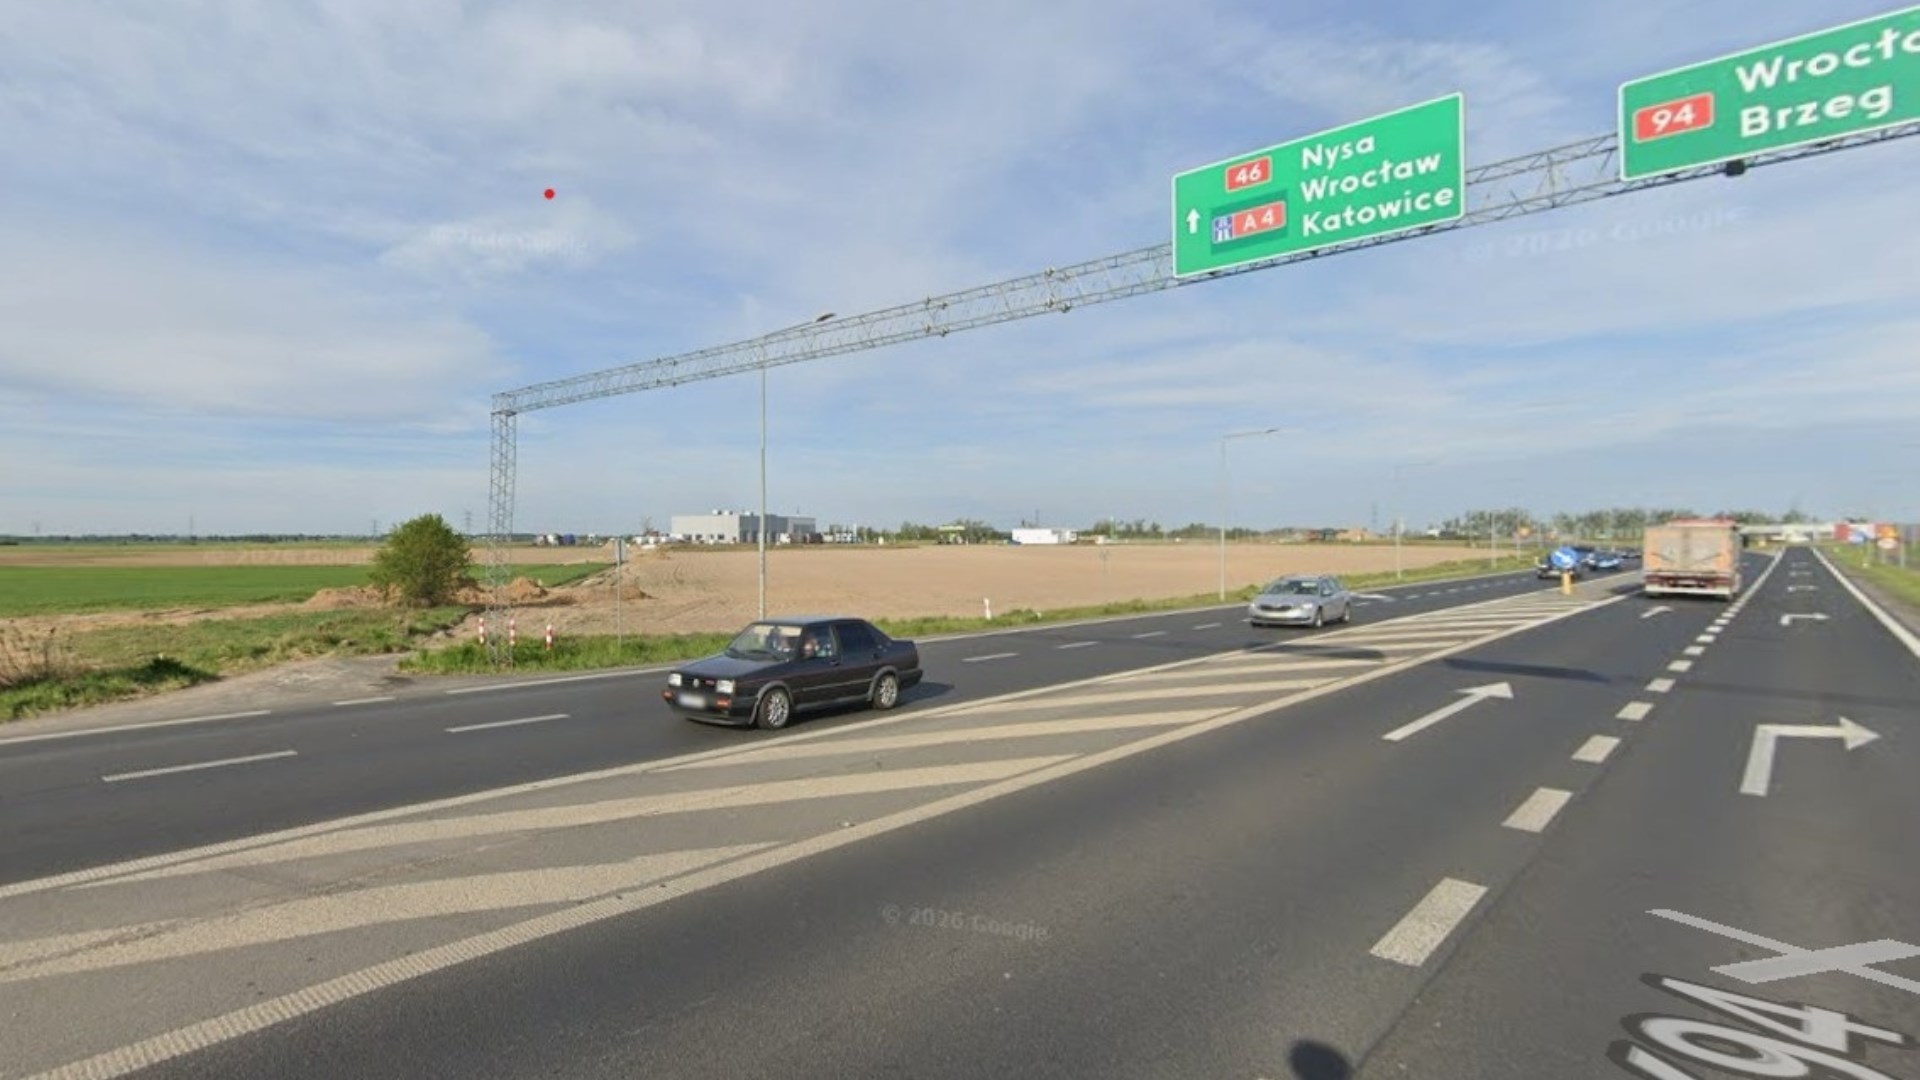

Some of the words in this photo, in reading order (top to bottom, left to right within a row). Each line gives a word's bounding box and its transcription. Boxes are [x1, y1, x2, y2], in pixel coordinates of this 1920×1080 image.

[1651, 103, 1696, 134] 94
[1740, 85, 1893, 137] Brzeg
[1302, 135, 1375, 170] Nysa
[1235, 162, 1262, 184] 46
[1300, 153, 1441, 202] Wrocław
[1243, 212, 1257, 232] A
[1261, 208, 1274, 225] 4
[1302, 187, 1454, 237] Katowice
